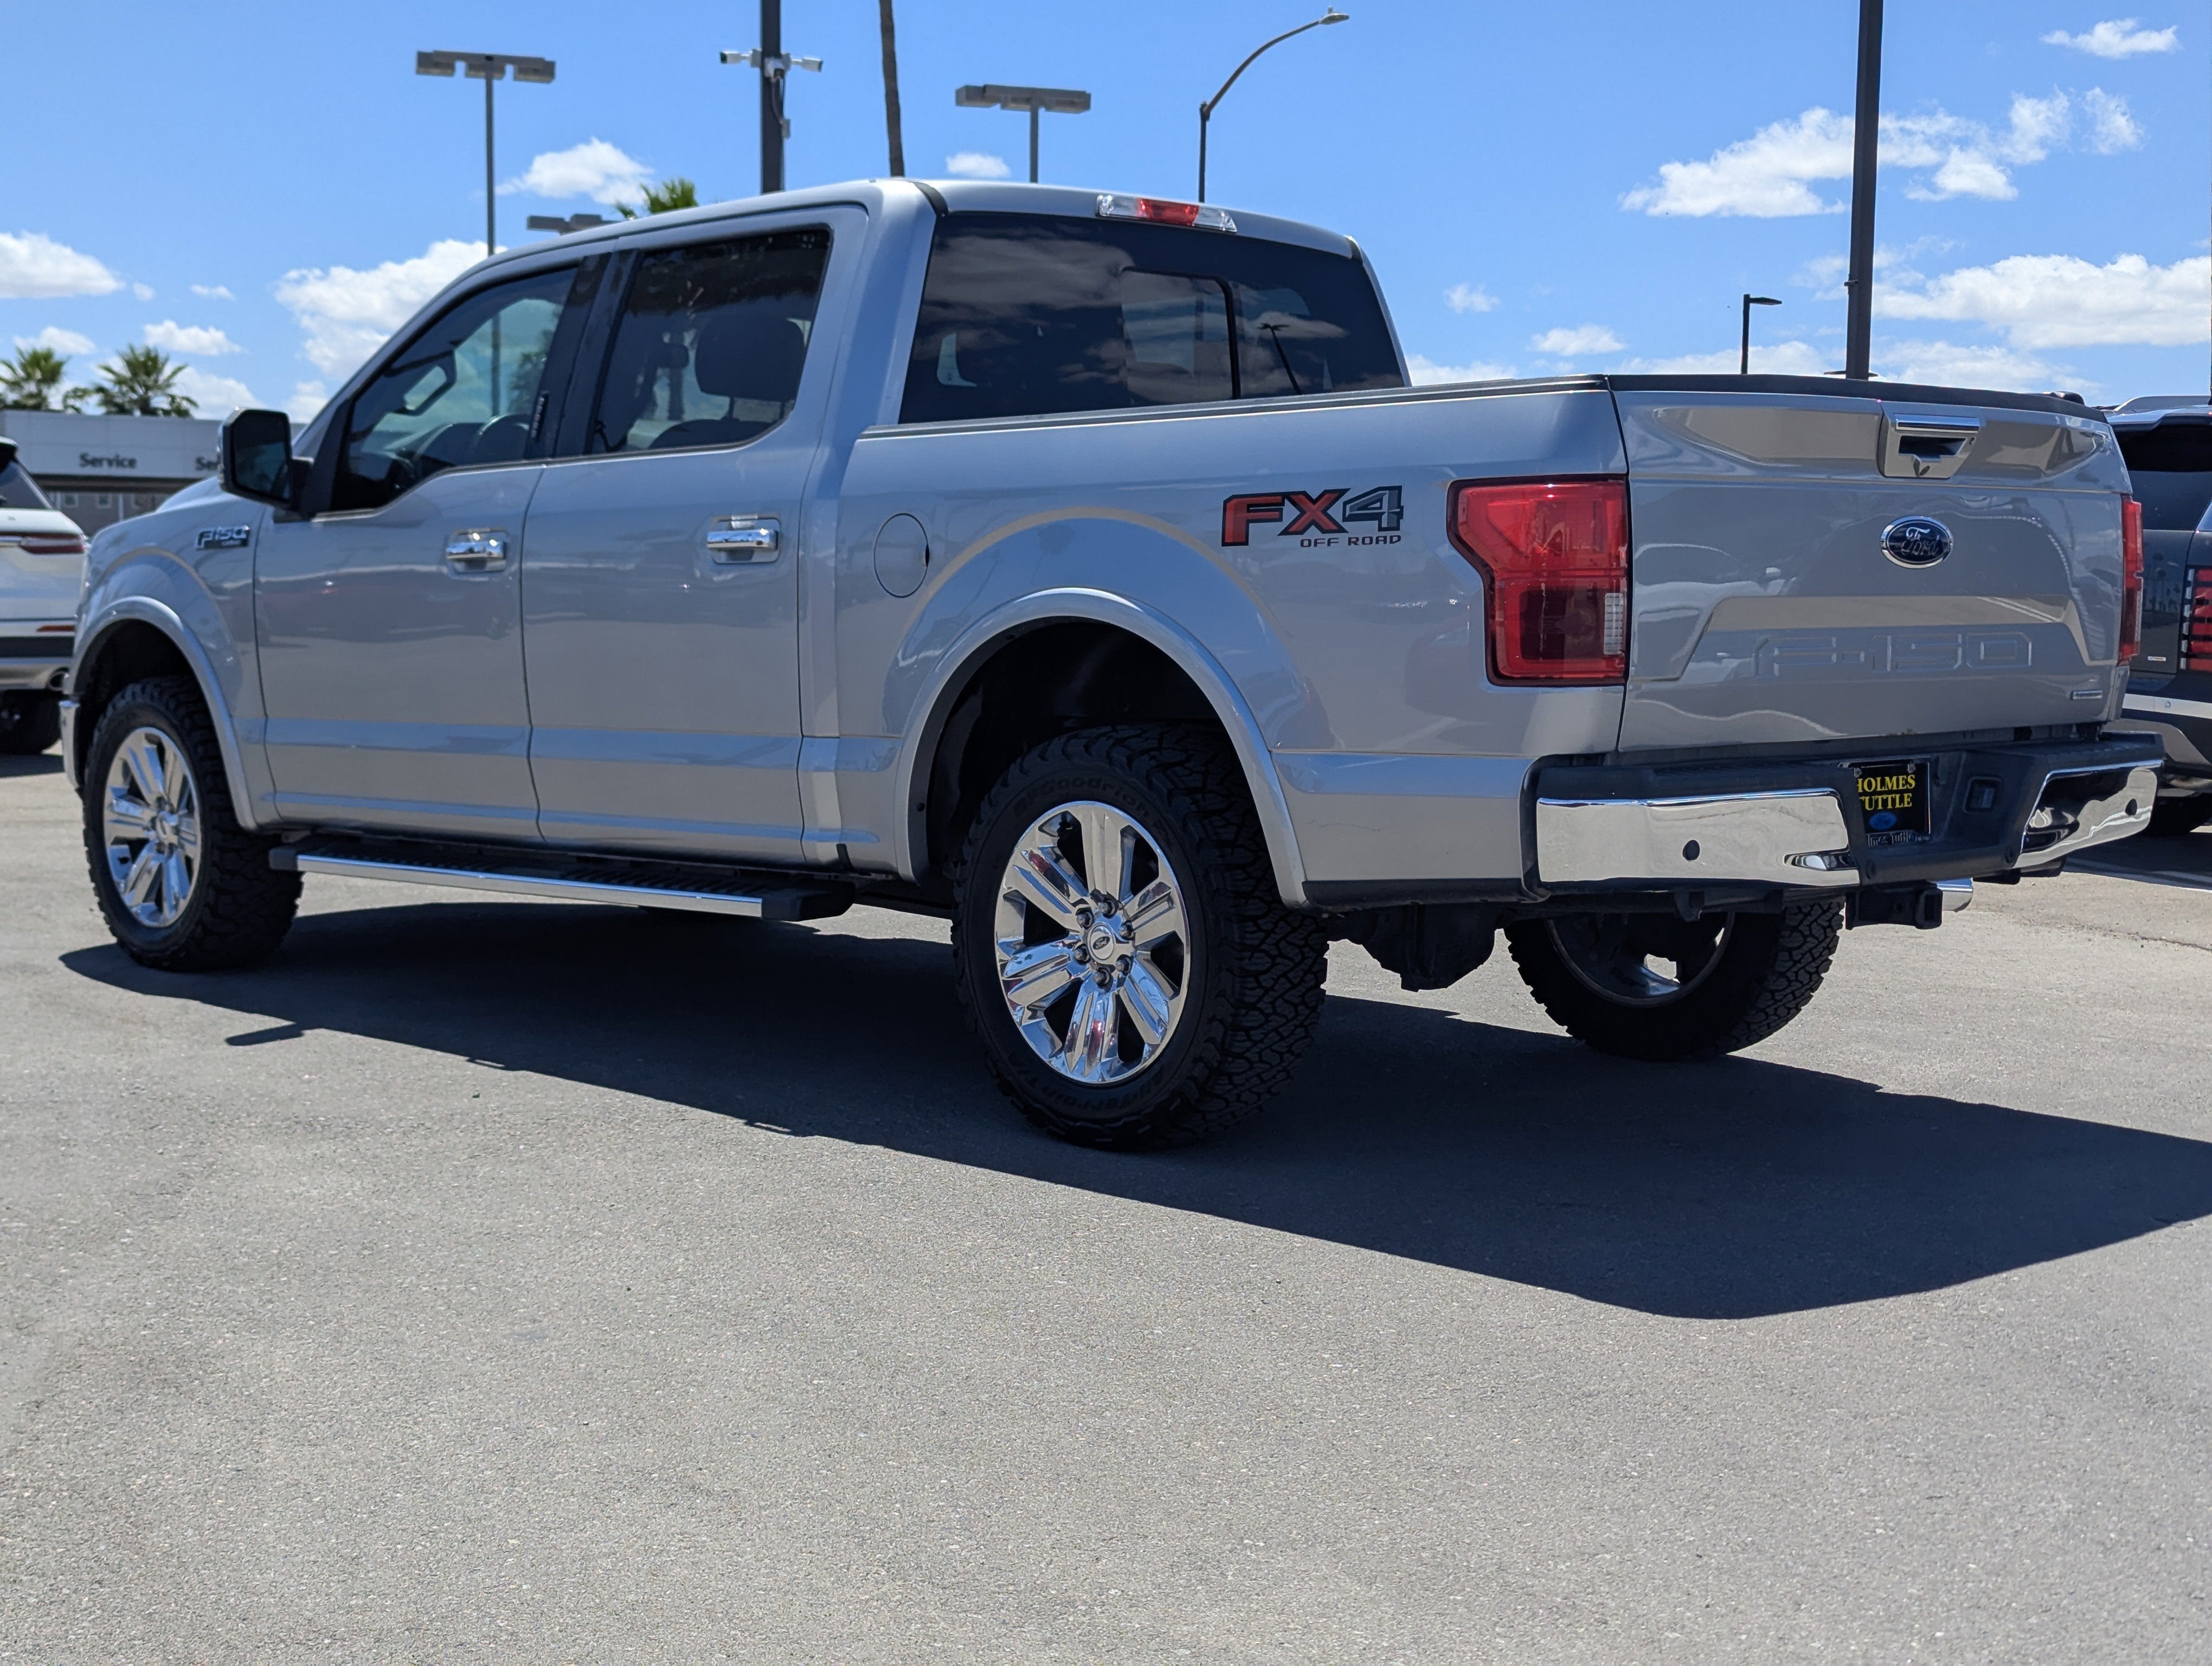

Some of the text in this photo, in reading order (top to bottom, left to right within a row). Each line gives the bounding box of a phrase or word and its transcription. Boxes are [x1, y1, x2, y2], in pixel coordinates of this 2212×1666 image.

[79, 453, 137, 469] Service
[1221, 485, 1404, 547] FX4
[1300, 535, 1401, 548] OFF ROAD
[1900, 526, 1940, 556] Ford
